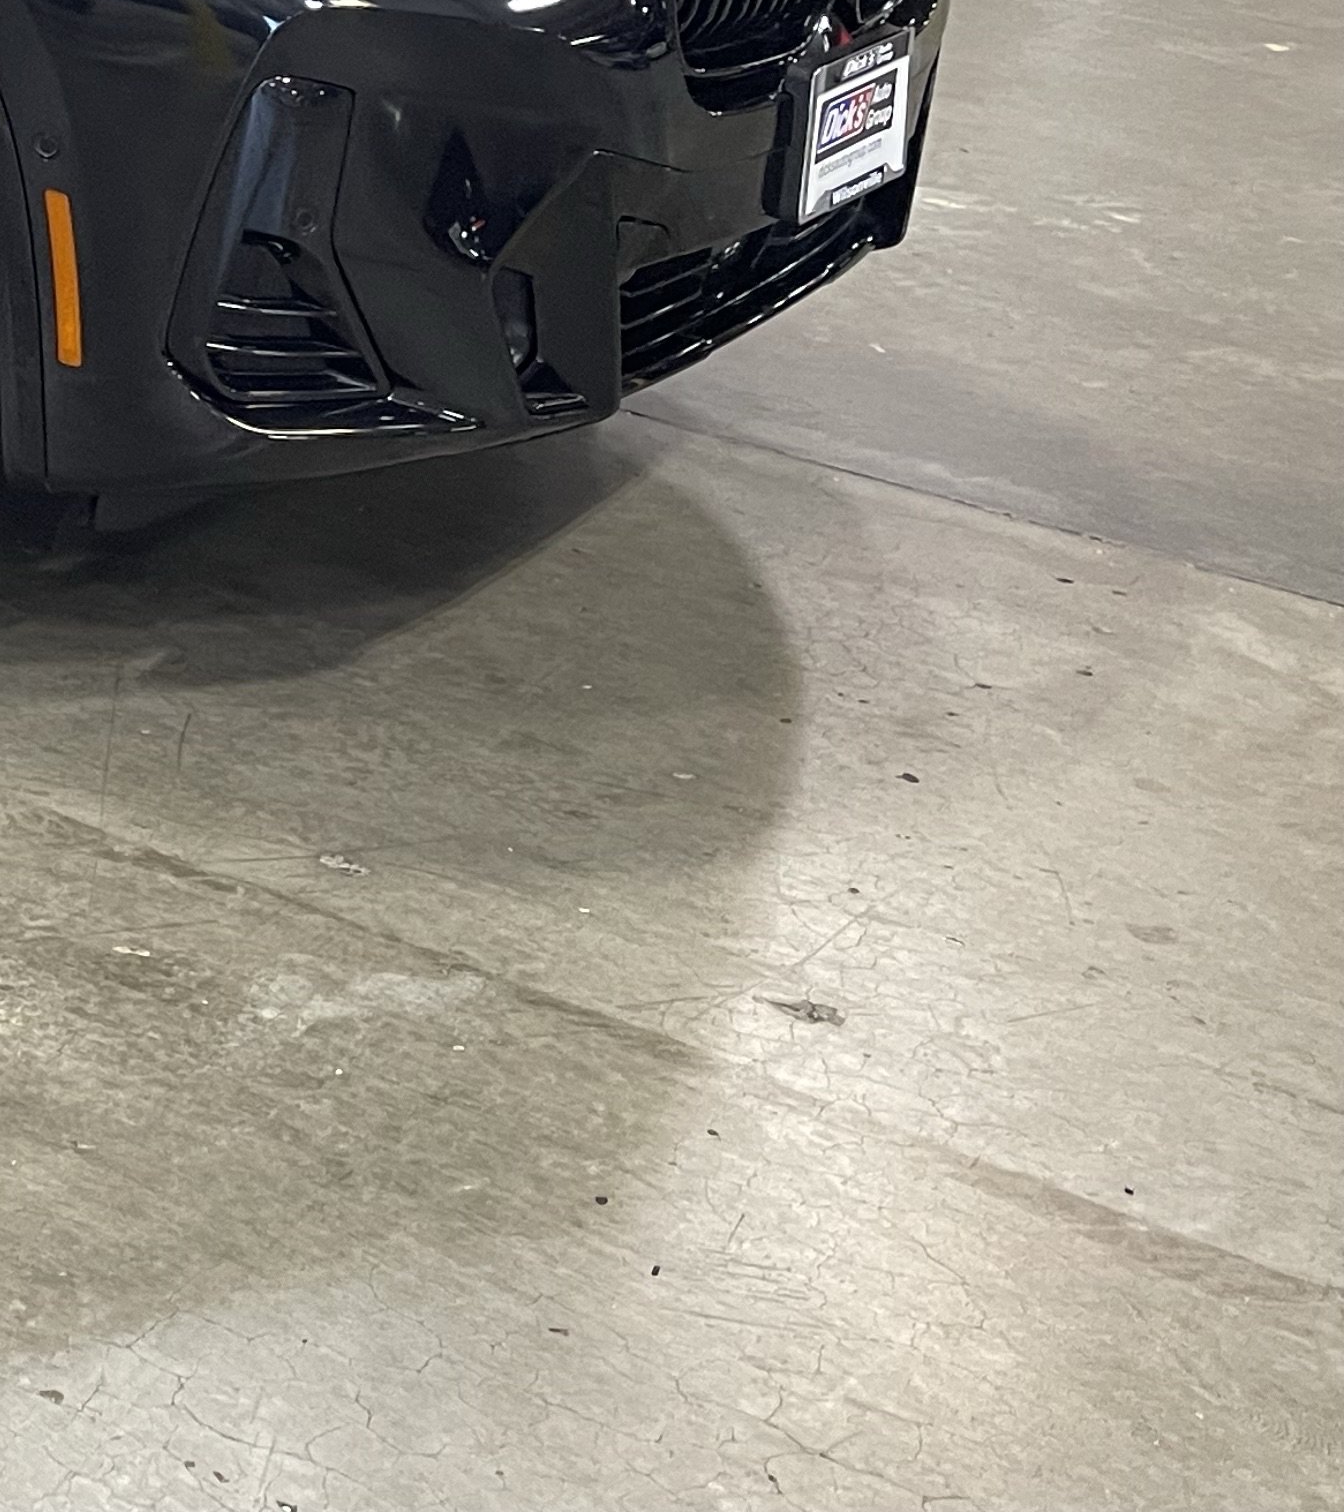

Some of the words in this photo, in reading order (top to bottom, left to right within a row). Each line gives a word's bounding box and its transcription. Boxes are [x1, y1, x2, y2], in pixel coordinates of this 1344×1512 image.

[820, 93, 869, 145] Dick's
[871, 83, 893, 105] Auto
[866, 104, 893, 130] Group
